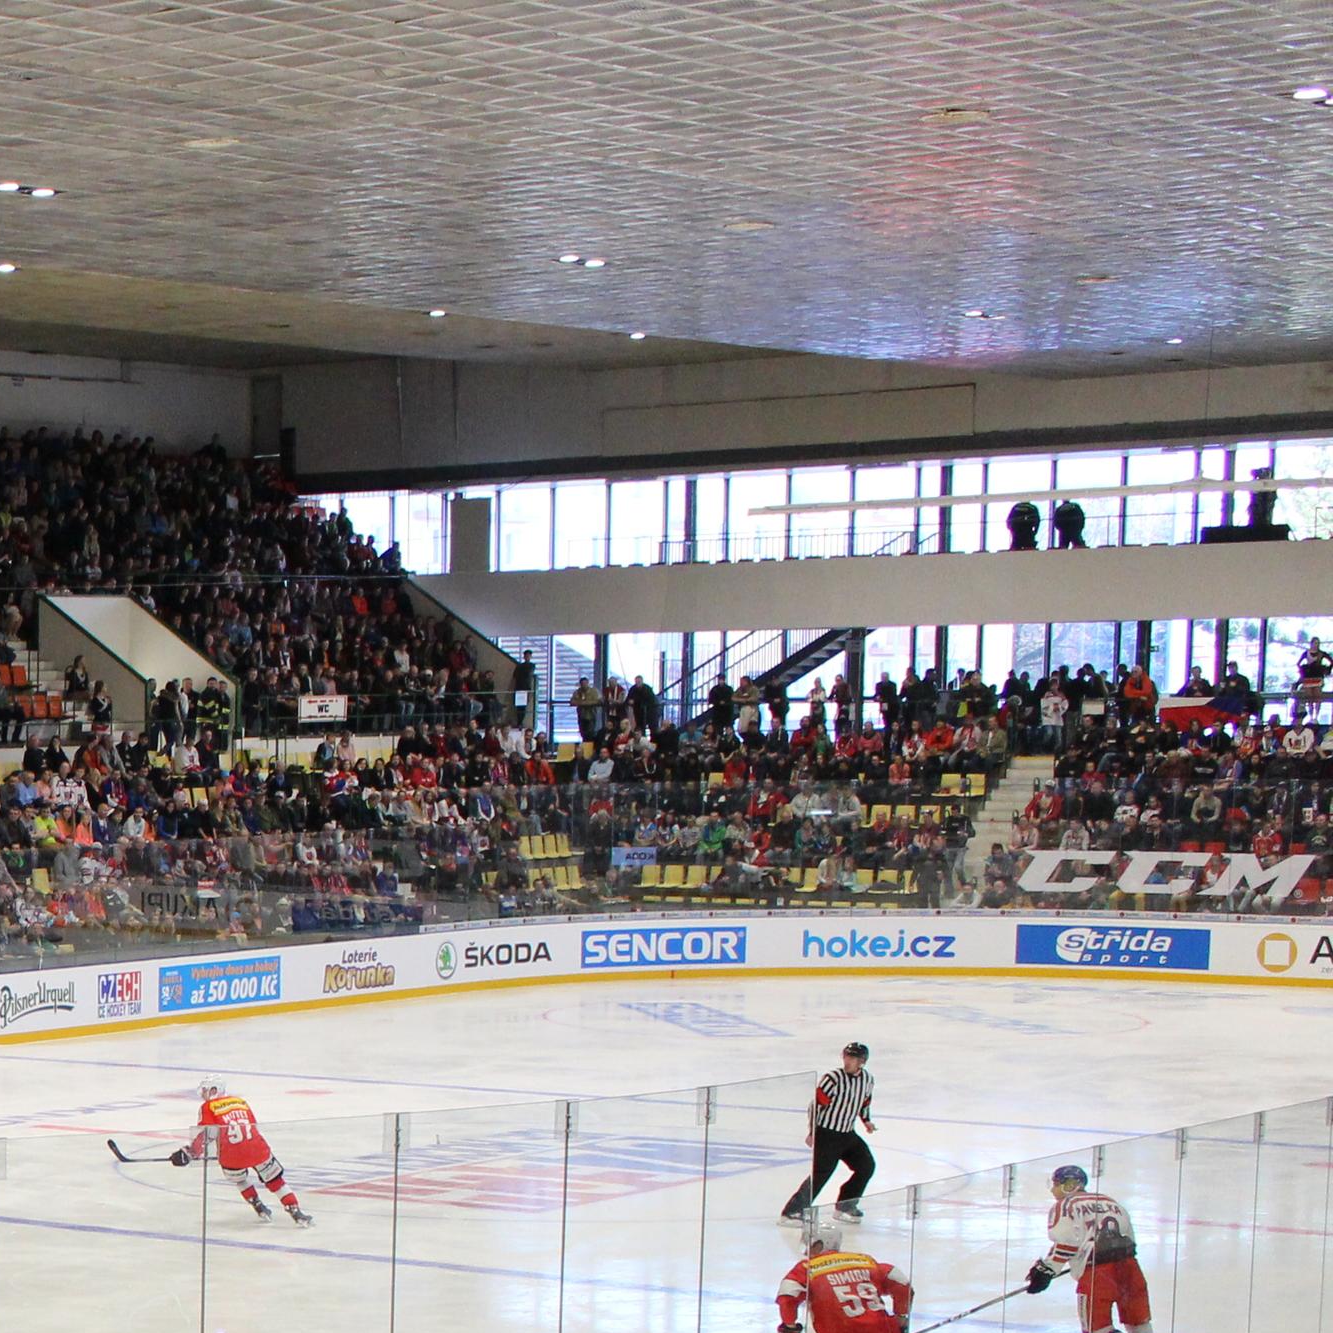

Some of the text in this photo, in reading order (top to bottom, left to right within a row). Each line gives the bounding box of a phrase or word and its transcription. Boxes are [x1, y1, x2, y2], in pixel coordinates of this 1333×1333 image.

[317, 703, 330, 713] WC
[1017, 850, 1317, 897] CCM
[341, 948, 378, 964] Loterie
[464, 941, 552, 969] ŠKODA
[584, 931, 738, 964] SENCOR
[802, 929, 956, 959] hokej.cz
[1083, 953, 1168, 965] sport
[98, 972, 142, 1000] CZECH
[191, 973, 278, 1005] až 50 000 Kč
[323, 962, 395, 993] Korunka
[0, 980, 76, 1028] Pilsner Urquell
[107, 1004, 126, 1017] HOCKEY
[127, 1002, 141, 1015] TEAM
[227, 1119, 253, 1144] 97
[832, 1282, 886, 1318] 59
